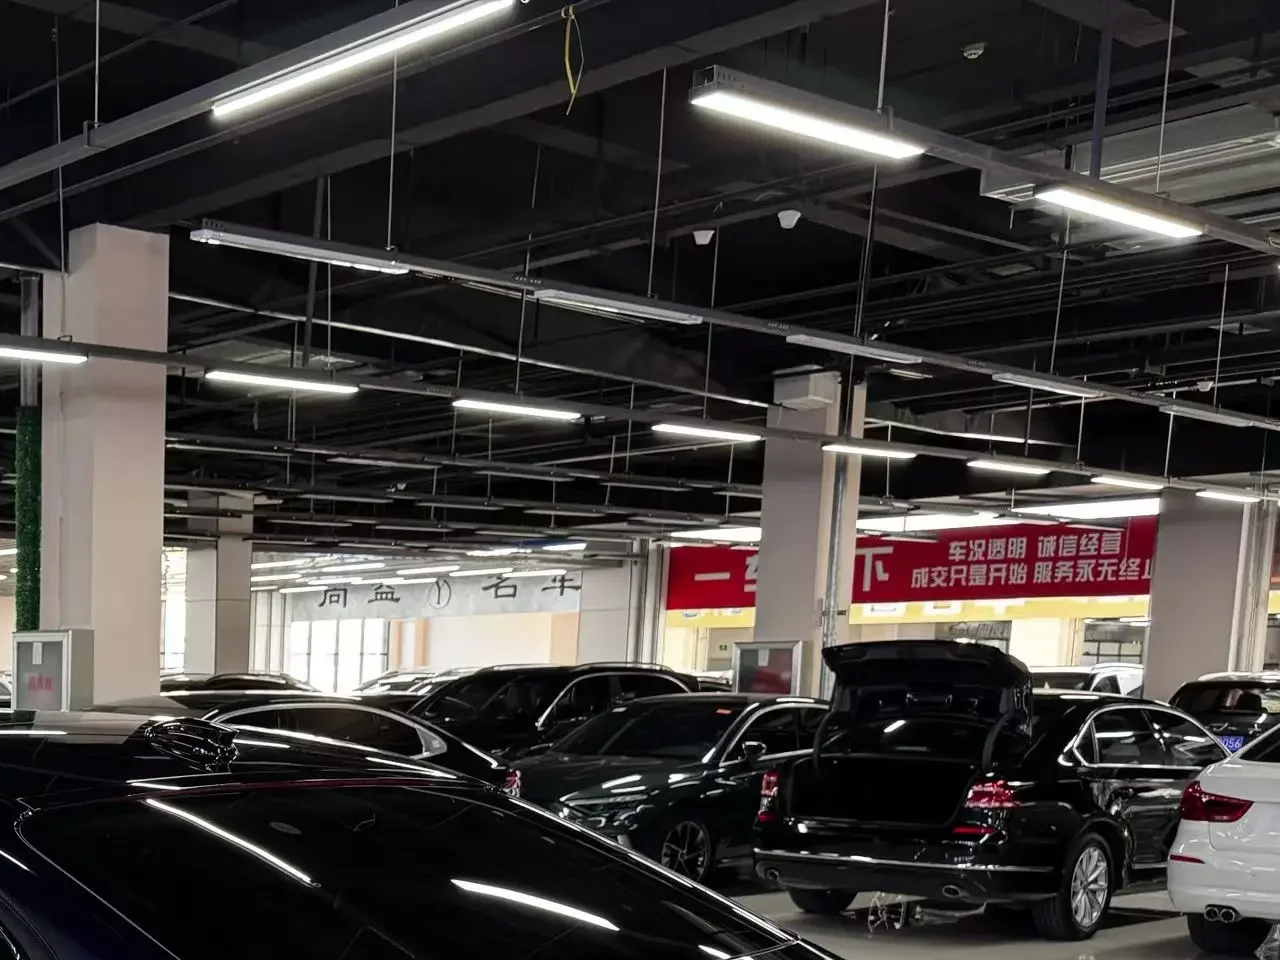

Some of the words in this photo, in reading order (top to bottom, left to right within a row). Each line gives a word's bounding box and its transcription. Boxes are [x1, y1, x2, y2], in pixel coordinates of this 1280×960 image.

[948, 536, 1027, 562] 车况透明
[1036, 532, 1122, 558] 诚信经营
[910, 561, 1028, 589] 成交只是开始
